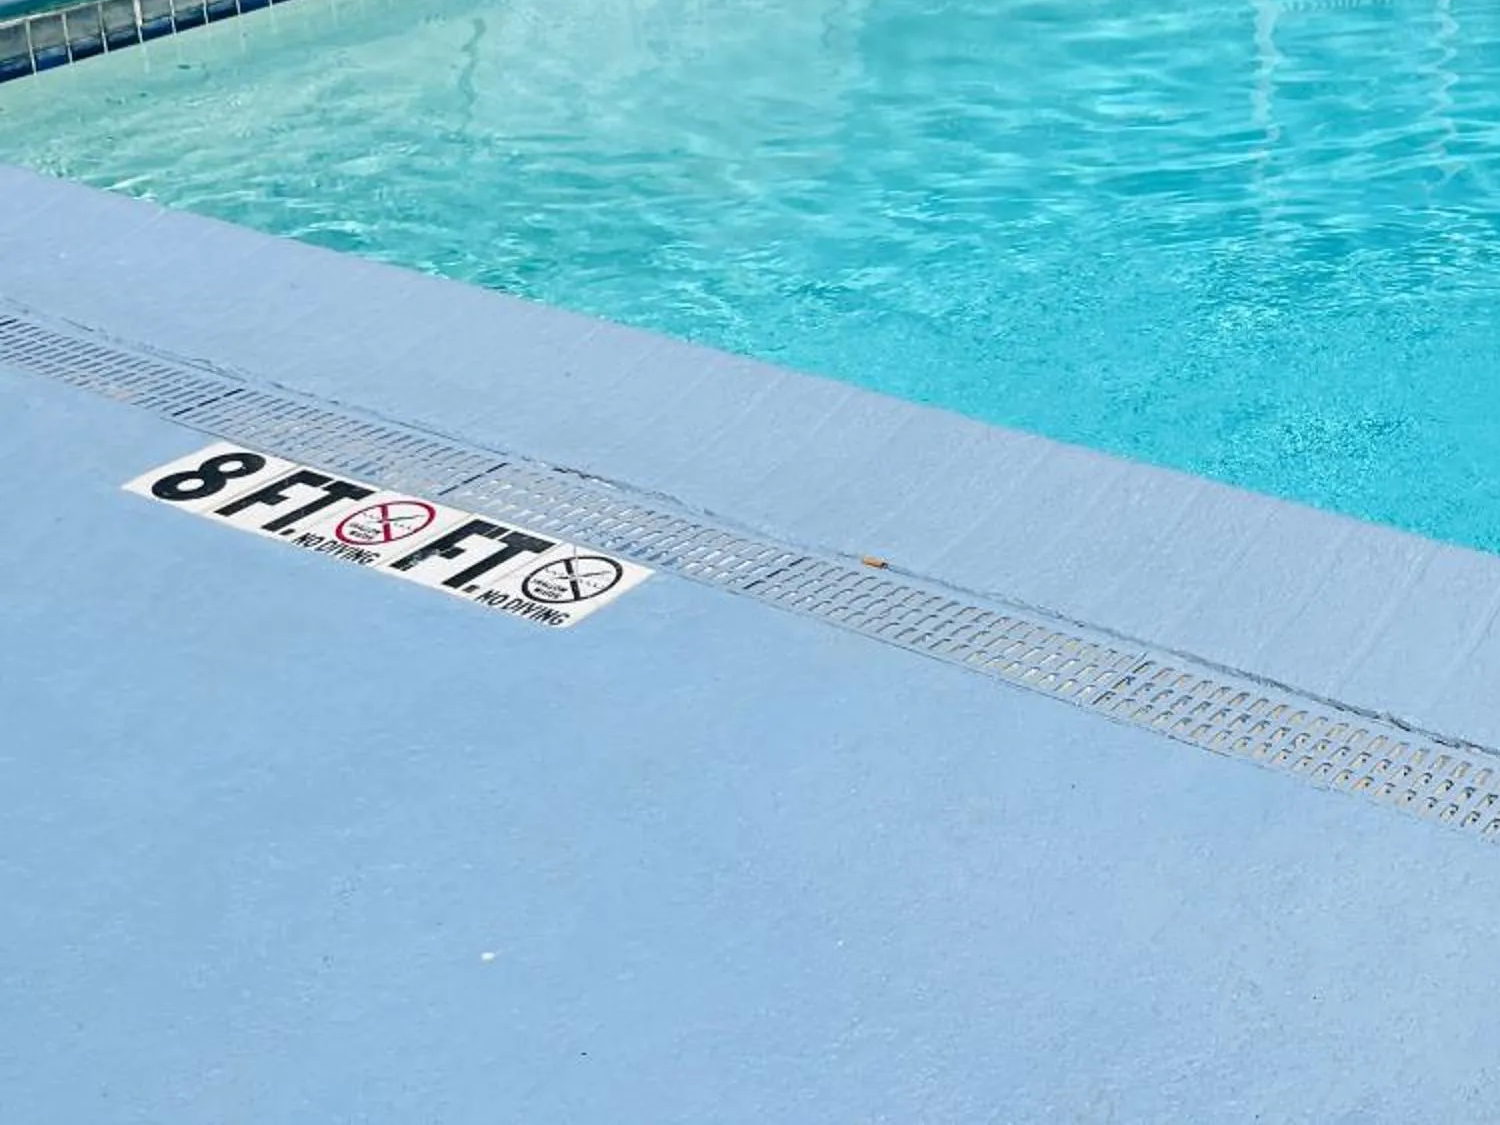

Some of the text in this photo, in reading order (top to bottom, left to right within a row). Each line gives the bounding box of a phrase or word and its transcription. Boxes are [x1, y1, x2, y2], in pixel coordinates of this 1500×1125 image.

[151, 453, 377, 536] 8 FT.
[292, 533, 380, 565] NO DIVING
[391, 518, 556, 593] FT.
[474, 589, 570, 625] NO DIVING
